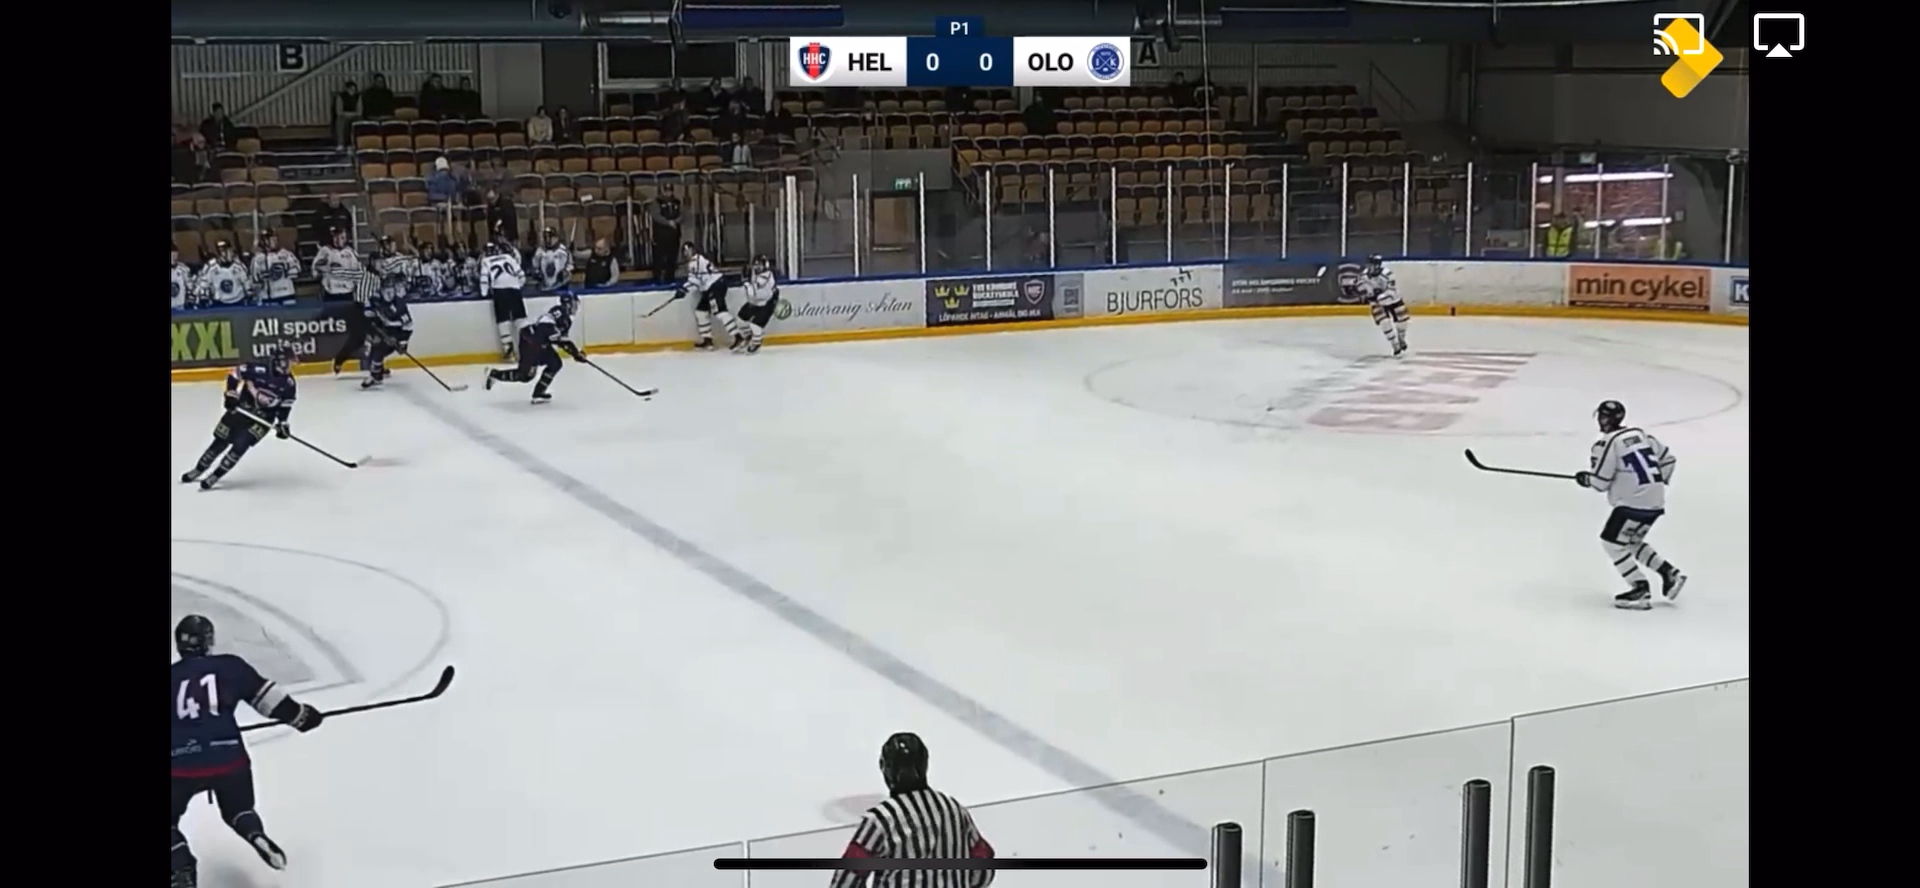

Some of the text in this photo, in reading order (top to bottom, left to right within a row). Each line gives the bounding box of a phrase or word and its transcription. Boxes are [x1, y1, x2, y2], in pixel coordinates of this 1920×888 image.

[280, 43, 303, 69] B
[1138, 42, 1157, 65] A
[490, 262, 518, 280] 20
[1576, 272, 1704, 301] min cykel
[1106, 288, 1203, 315] BJURFORS
[171, 321, 240, 361] XXL
[252, 317, 347, 338] All sports
[1621, 446, 1664, 486] 15
[176, 673, 219, 719] 41
